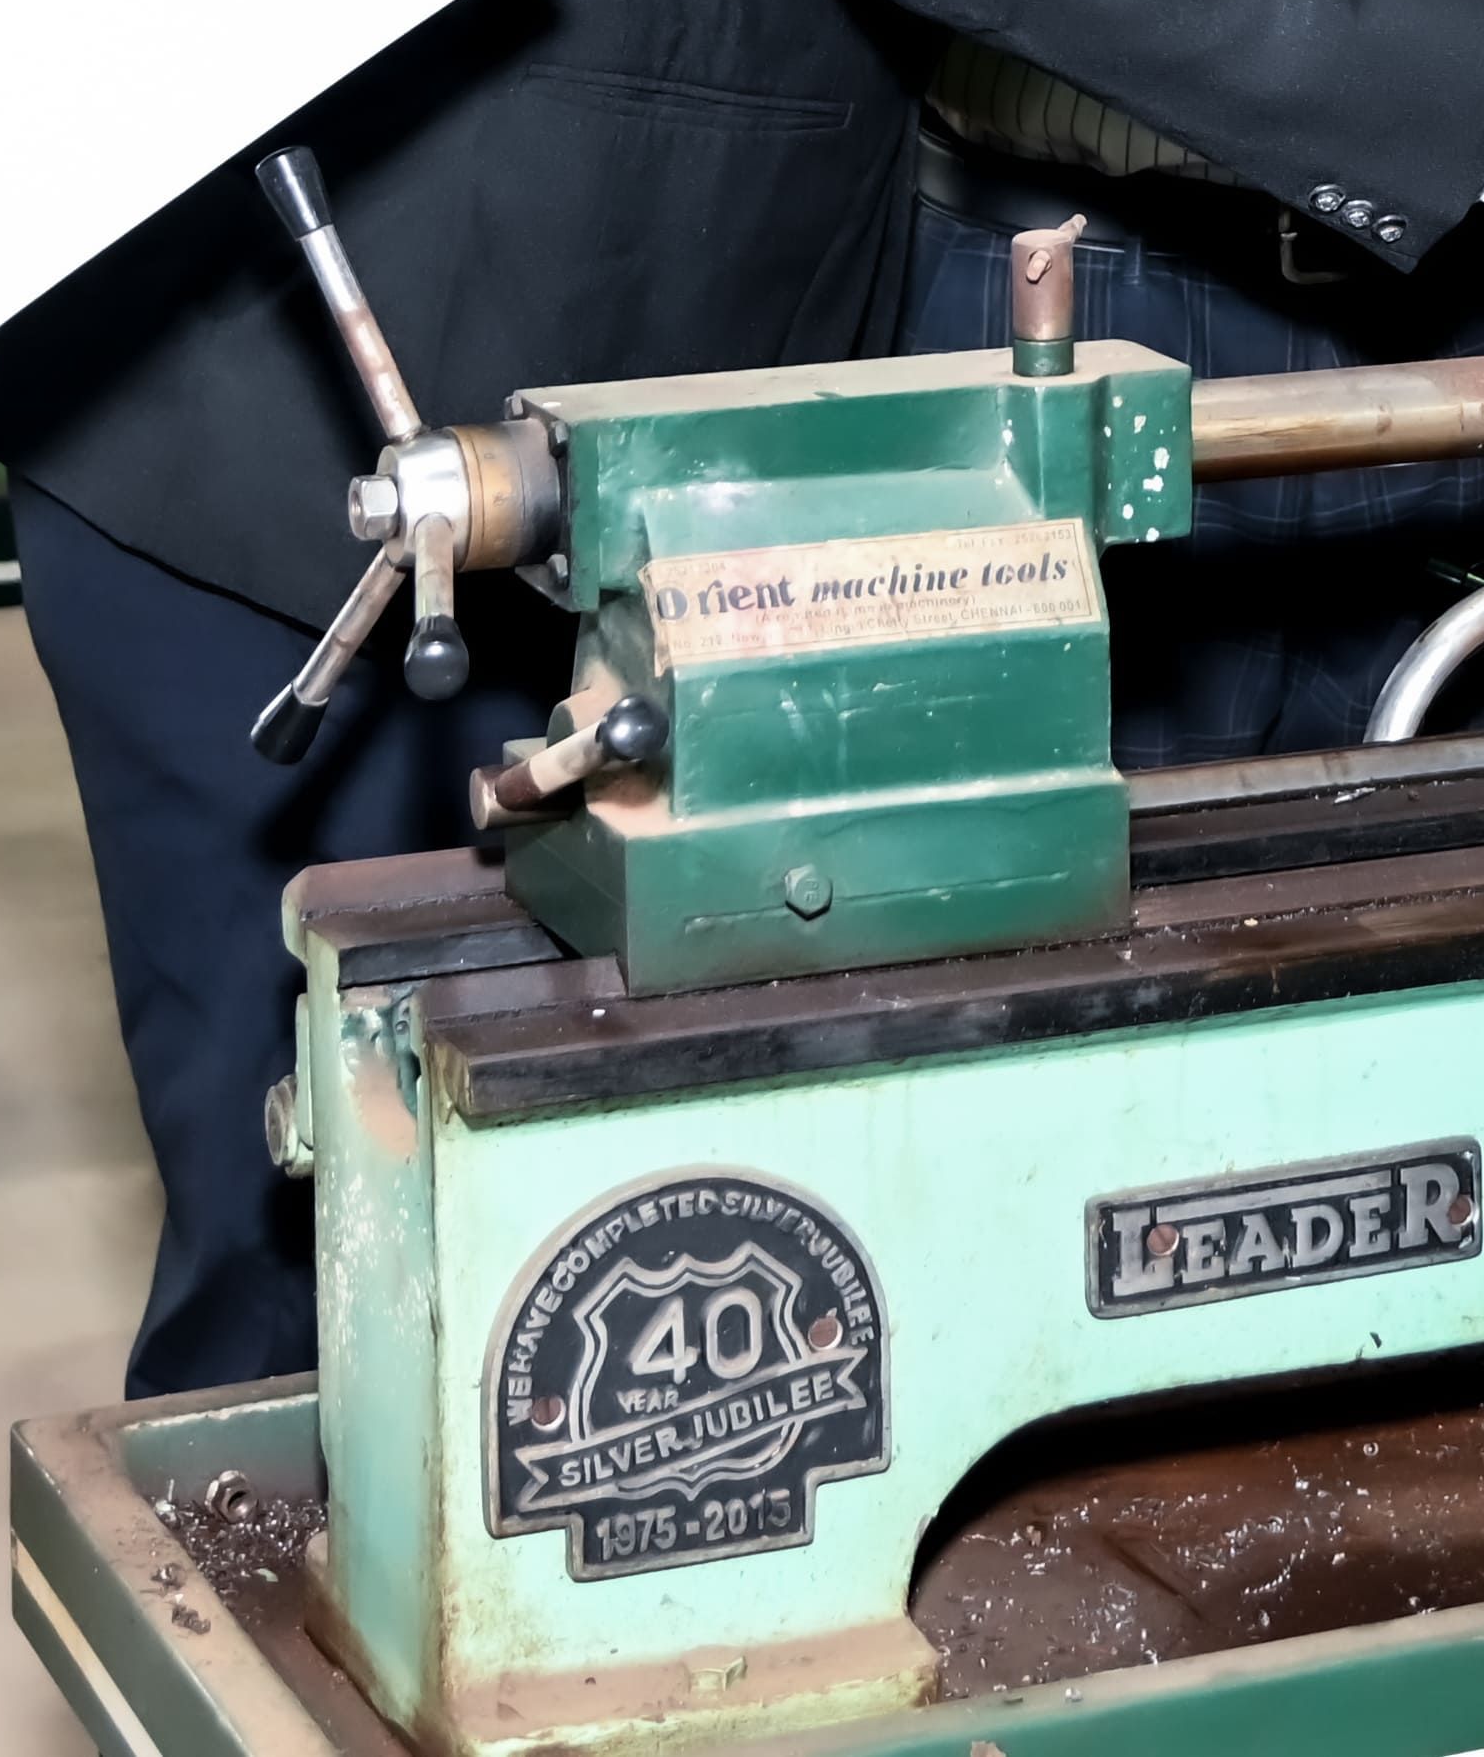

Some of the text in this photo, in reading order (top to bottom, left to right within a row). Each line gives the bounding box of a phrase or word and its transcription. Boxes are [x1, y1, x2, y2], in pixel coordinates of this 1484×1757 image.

[656, 575, 796, 621] Orient
[809, 562, 969, 603] machine
[980, 551, 1068, 588] tools
[552, 1189, 719, 1292] COMPLETED
[1112, 1162, 1464, 1298] LEADER
[628, 1286, 765, 1385] 40
[559, 1371, 835, 1488] SILVER JUBILEE
[616, 1384, 680, 1415] YEAR
